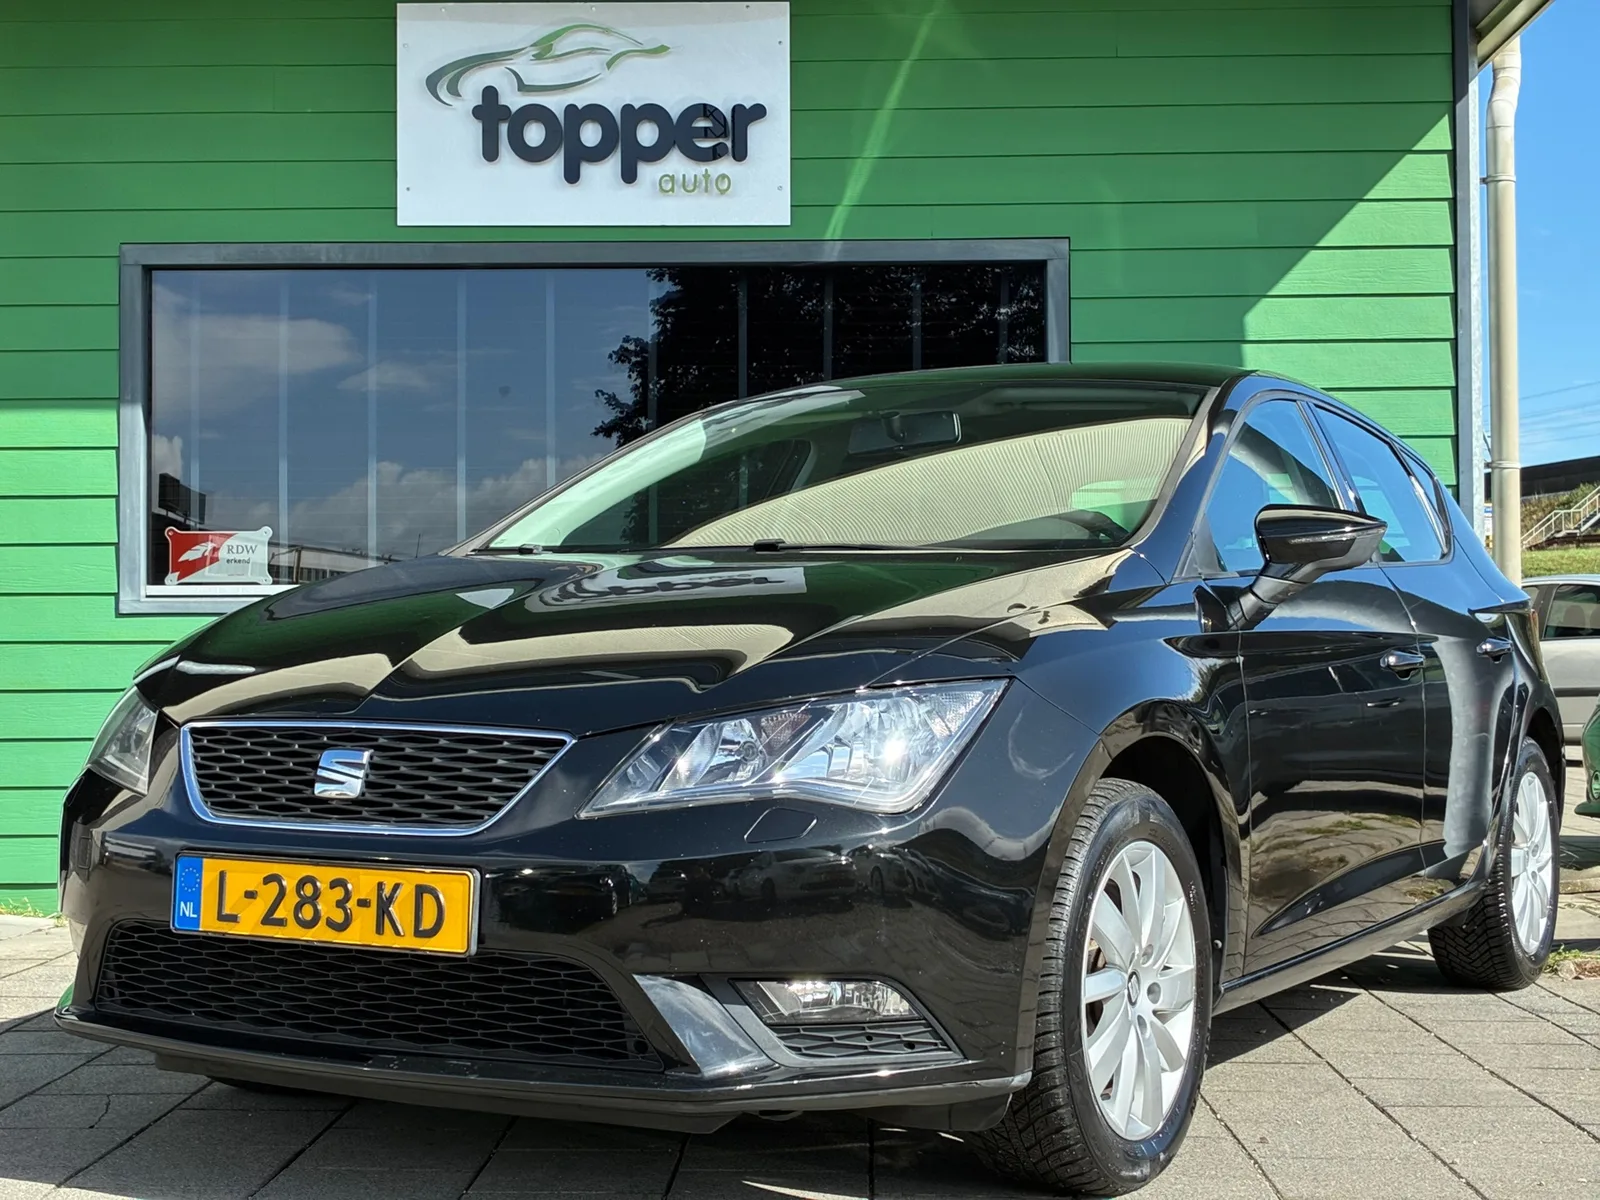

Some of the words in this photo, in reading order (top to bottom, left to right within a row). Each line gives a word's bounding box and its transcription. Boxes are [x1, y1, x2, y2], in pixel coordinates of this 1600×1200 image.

[472, 85, 767, 184] topper
[659, 169, 732, 194] auto
[227, 544, 258, 555] RDW
[226, 557, 251, 565] erkend
[180, 902, 198, 918] NL
[217, 870, 445, 938] L-283-KD
